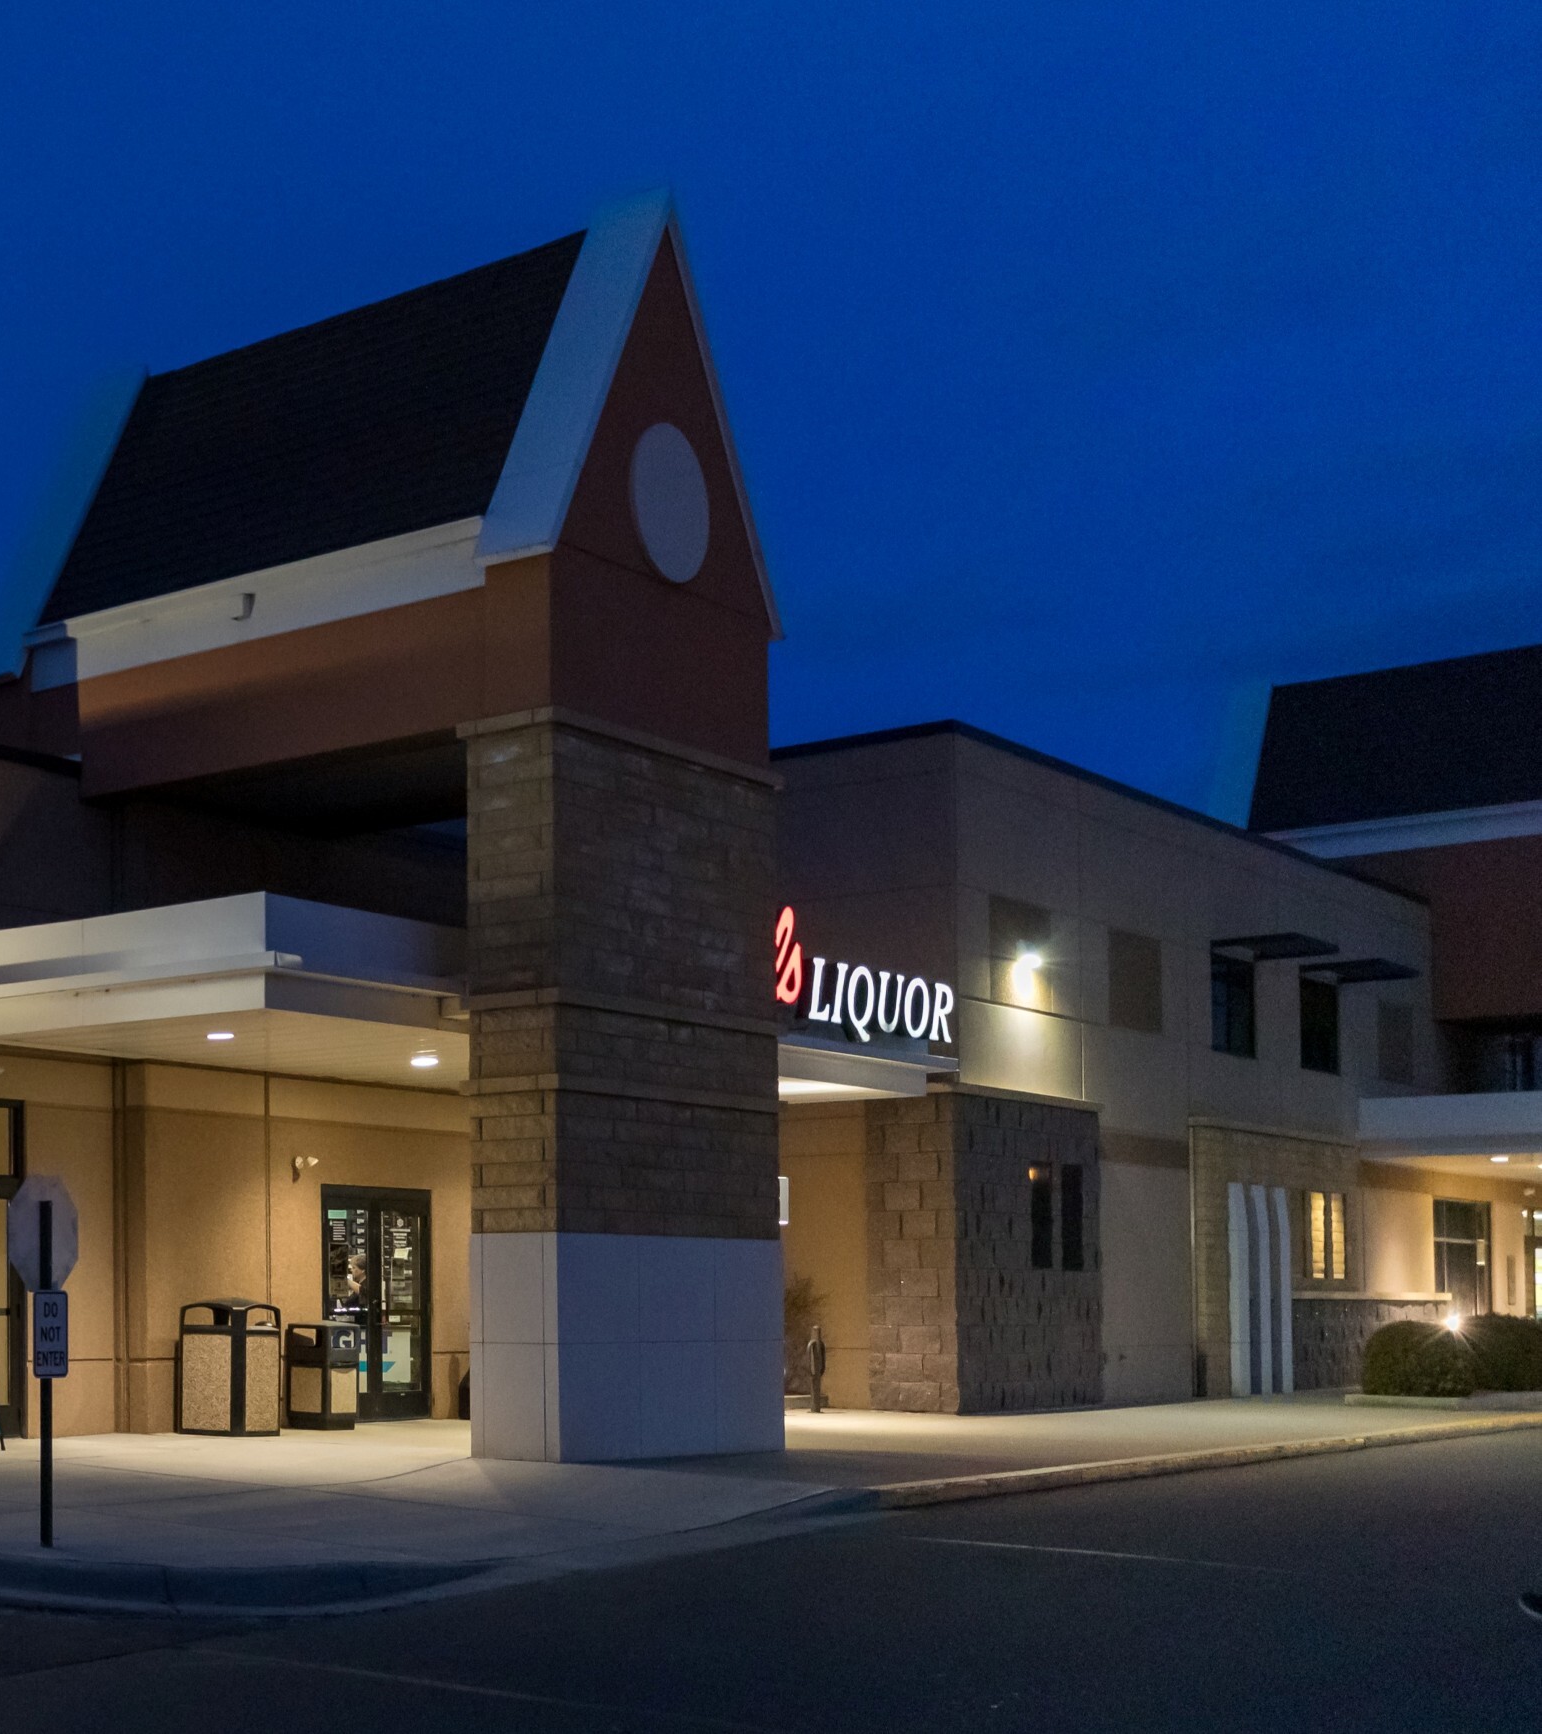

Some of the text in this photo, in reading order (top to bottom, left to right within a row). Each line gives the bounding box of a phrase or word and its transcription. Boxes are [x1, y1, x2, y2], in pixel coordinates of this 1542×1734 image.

[808, 957, 954, 1043] LIQUOR
[43, 1302, 58, 1318] DO
[40, 1326, 61, 1342] NOT
[36, 1351, 65, 1367] ENTER
